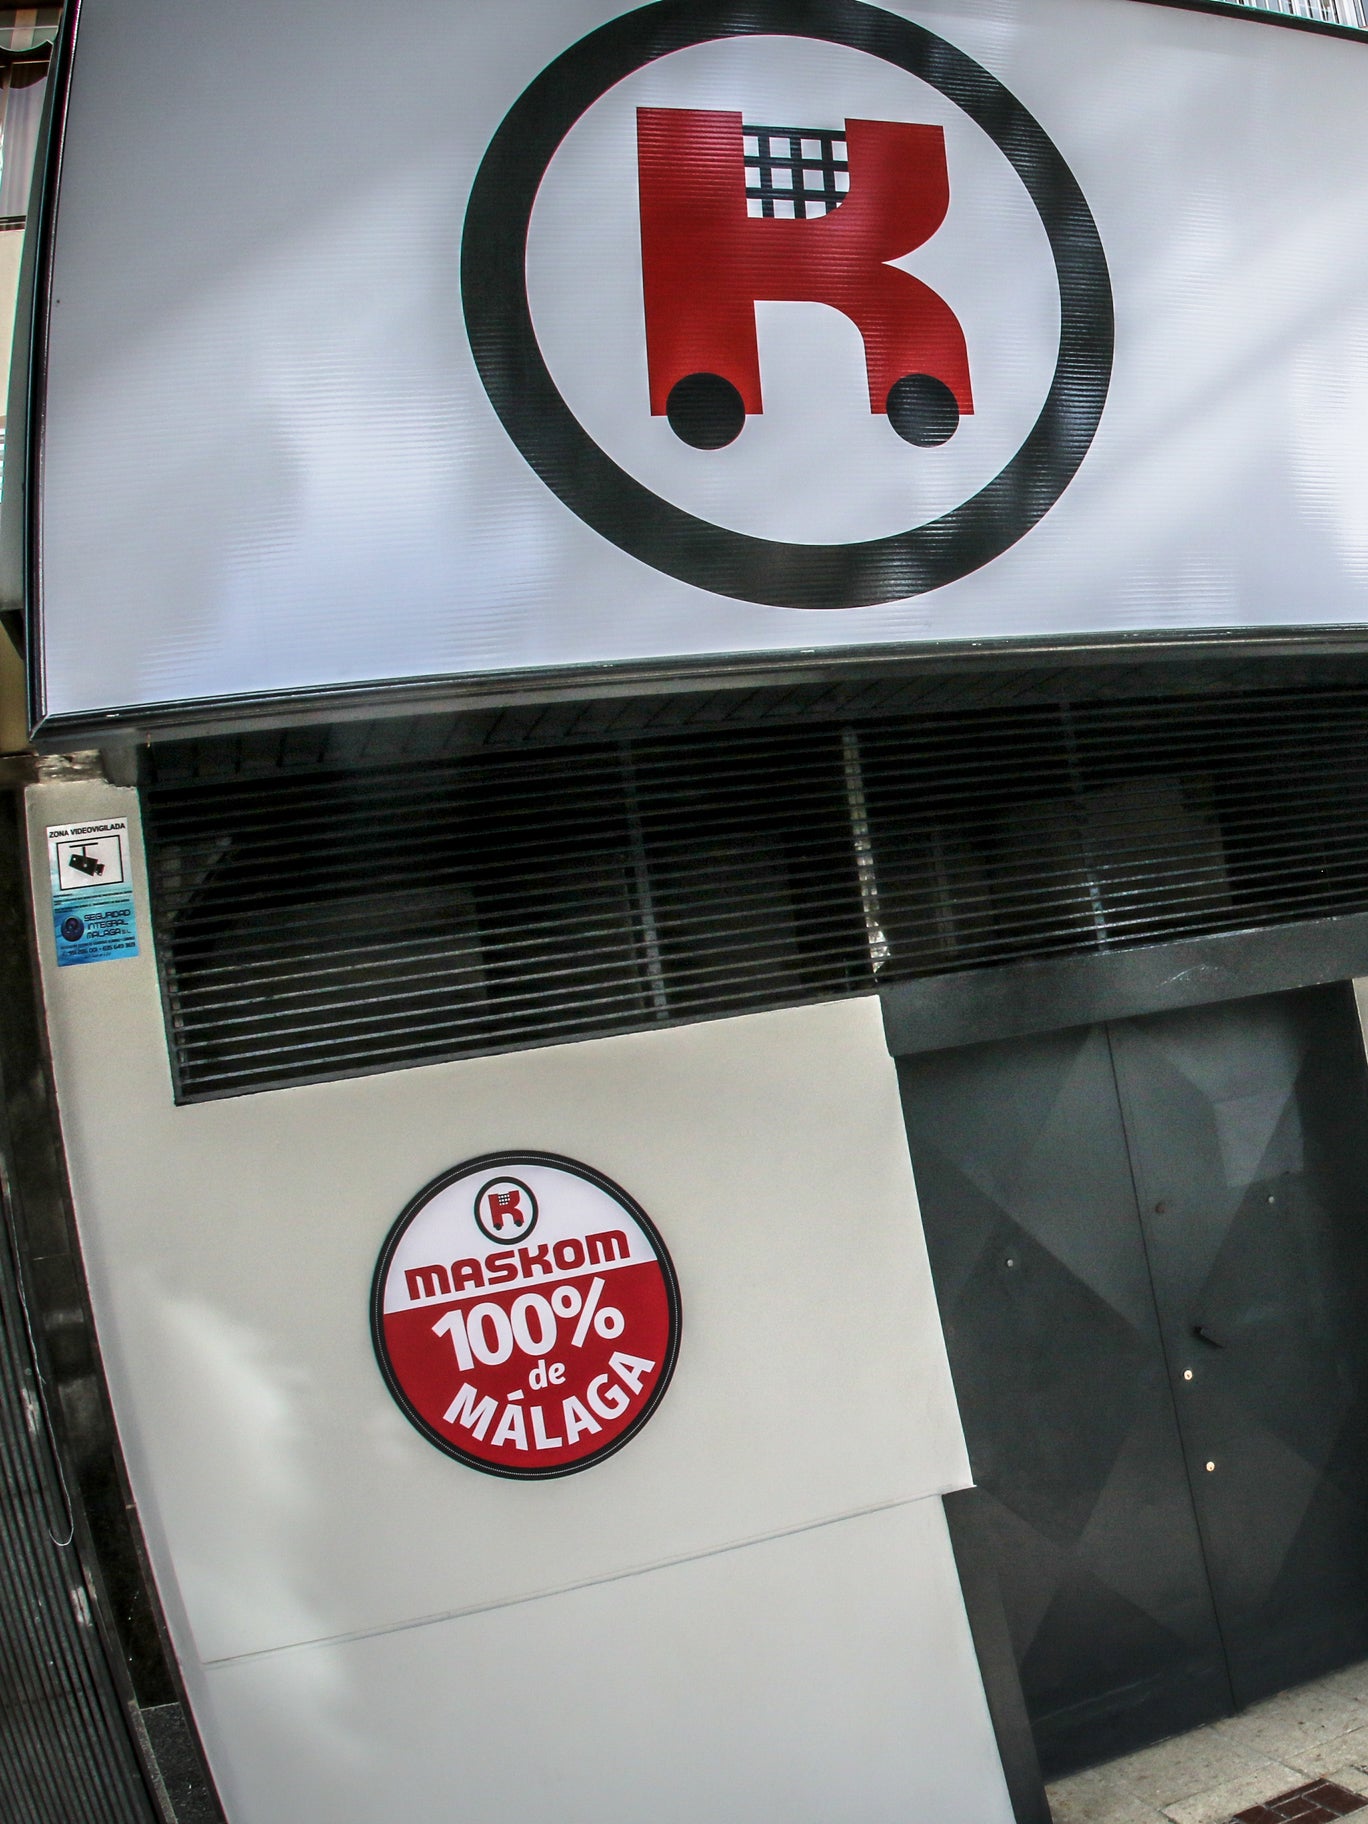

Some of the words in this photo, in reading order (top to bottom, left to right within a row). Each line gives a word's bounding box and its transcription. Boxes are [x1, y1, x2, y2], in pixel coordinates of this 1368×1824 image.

[48, 829, 69, 839] ZONA
[70, 822, 126, 836] VIDEOVIGILADA
[404, 1229, 631, 1301] MASKOM
[431, 1276, 625, 1372] 100%
[442, 1351, 656, 1451] MÁLAGA
[528, 1358, 566, 1391] de
